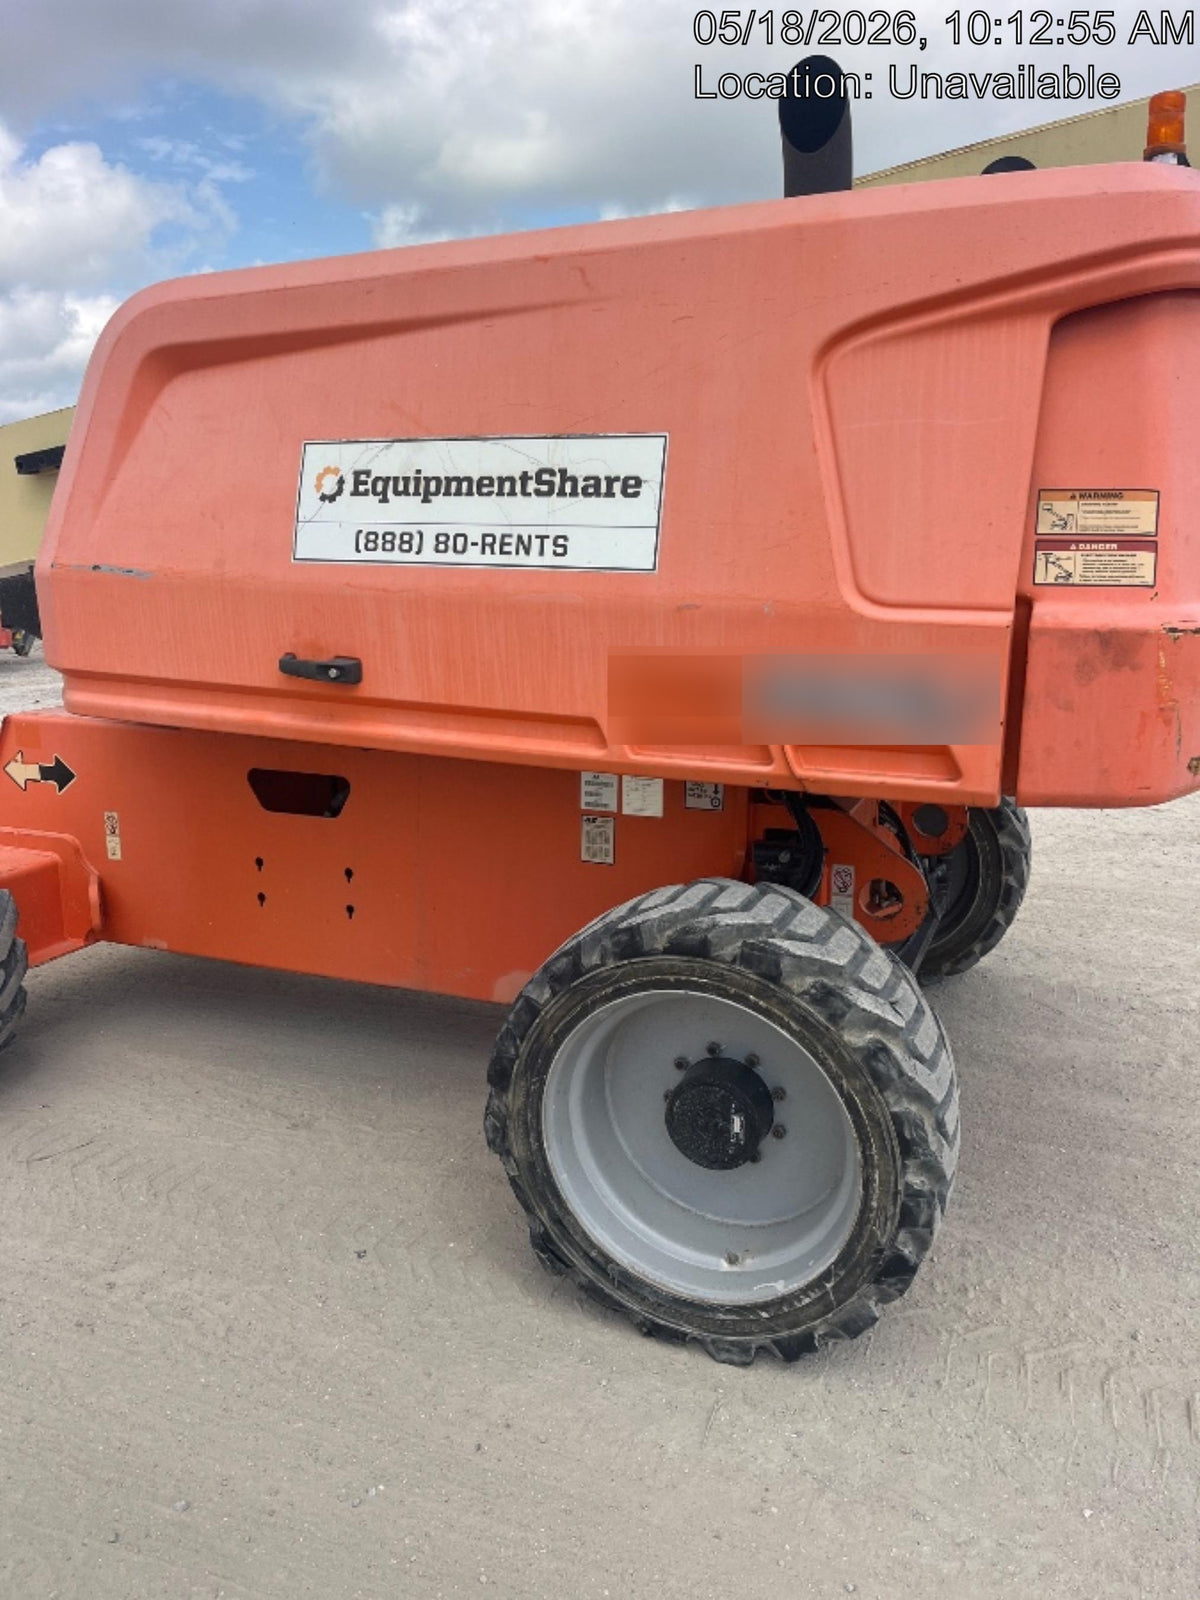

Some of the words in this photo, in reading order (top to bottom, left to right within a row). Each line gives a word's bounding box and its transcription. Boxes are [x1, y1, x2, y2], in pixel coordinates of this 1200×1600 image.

[350, 468, 643, 503] EquipmentShare
[1079, 492, 1124, 501] WARNING
[354, 530, 424, 554] (888)
[434, 532, 569, 557] 80-RENTS
